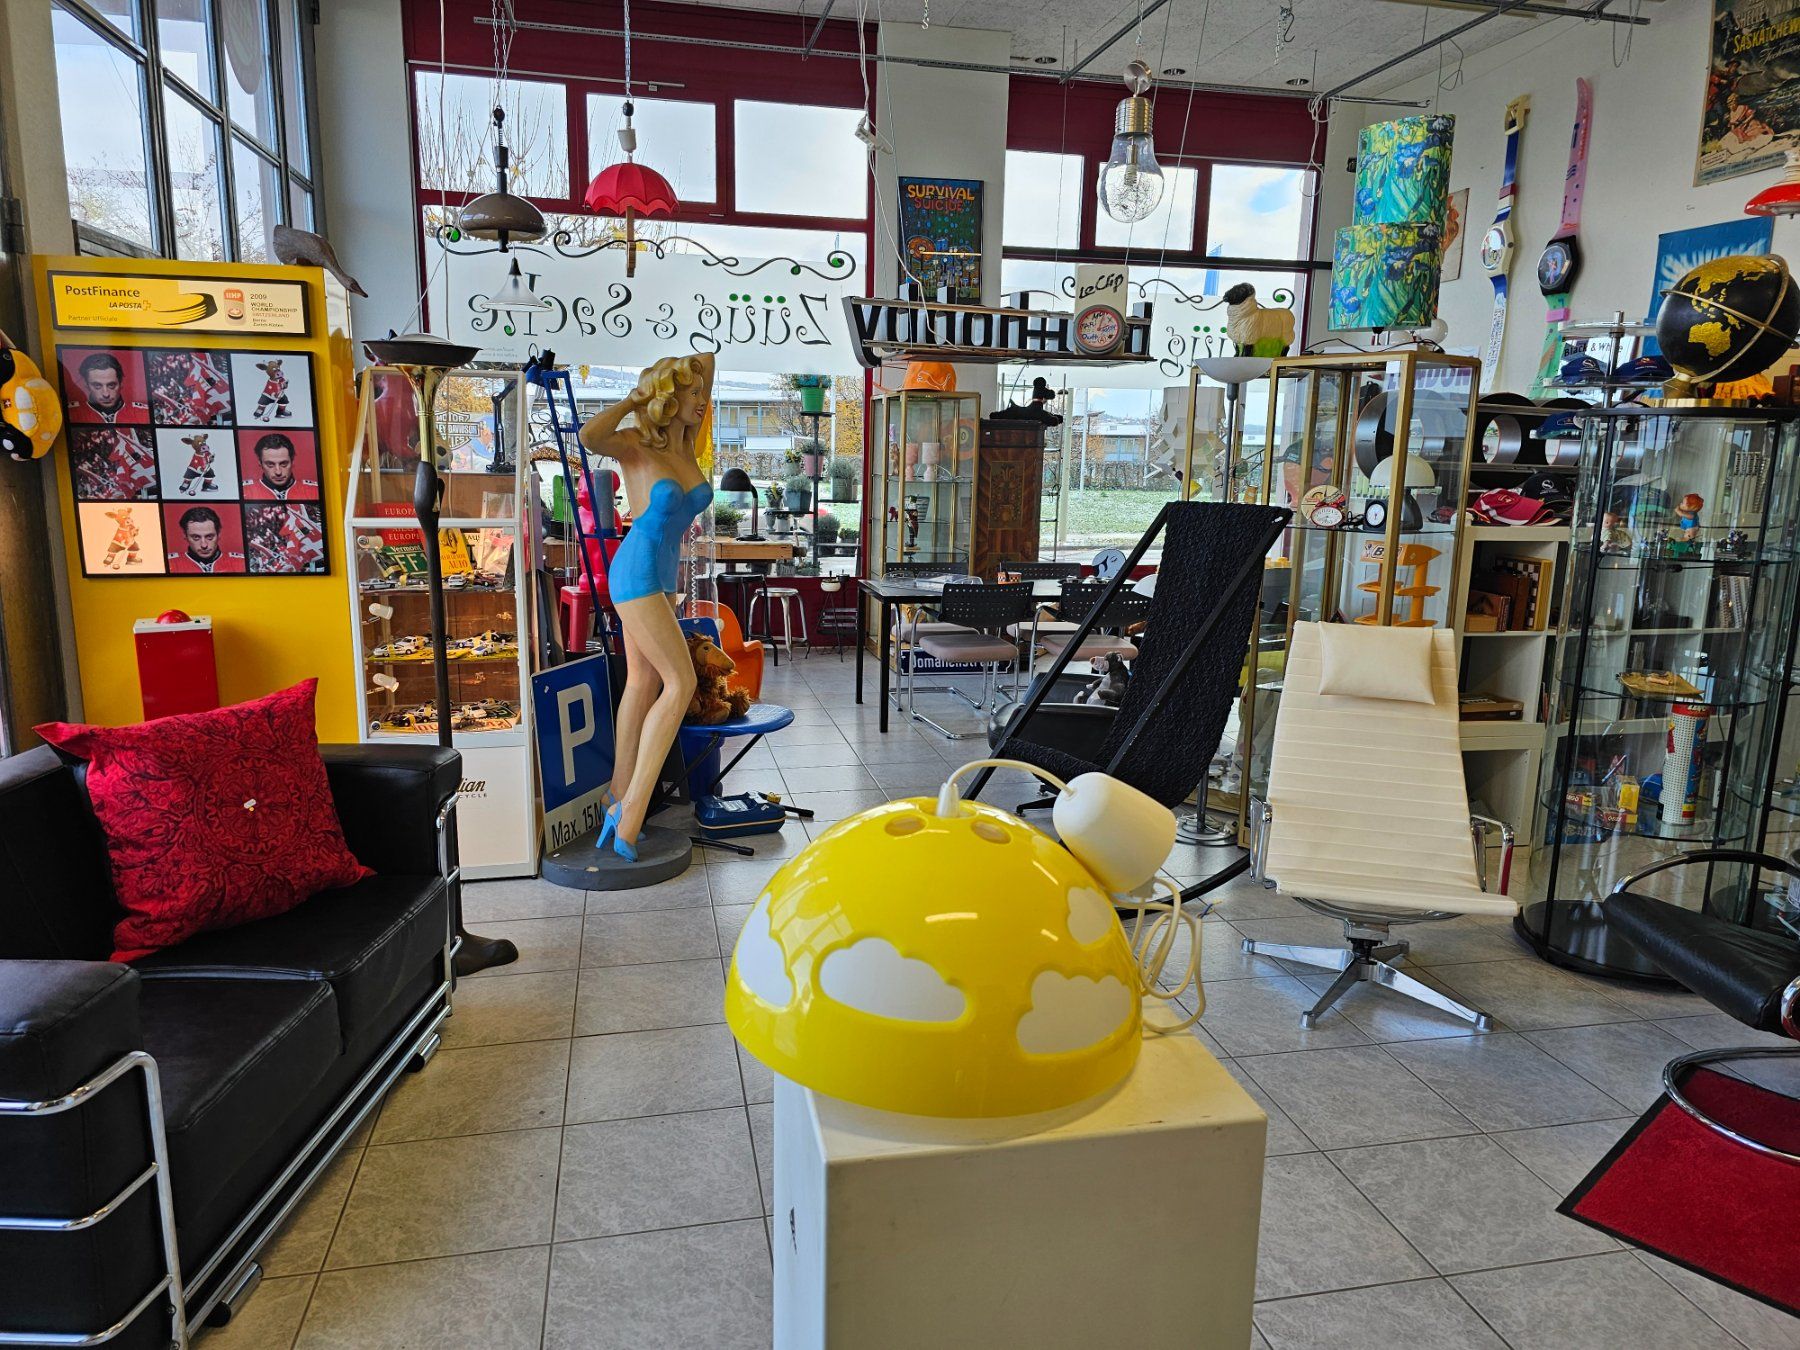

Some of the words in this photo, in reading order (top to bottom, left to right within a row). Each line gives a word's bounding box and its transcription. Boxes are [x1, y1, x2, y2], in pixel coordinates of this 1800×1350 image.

[1733, 17, 1800, 54] SASKATCHEW
[907, 184, 976, 201] SURVIVAL
[914, 198, 964, 212] SUICIDE
[65, 285, 141, 298] PostFinance
[108, 301, 118, 309] LA
[118, 301, 142, 309] POSTA
[1564, 343, 1587, 357] Black
[1590, 342, 1597, 352] &
[1387, 367, 1472, 391] LNDON
[391, 545, 422, 553] Vermont
[556, 682, 596, 787] P
[551, 820, 582, 850] Max.
